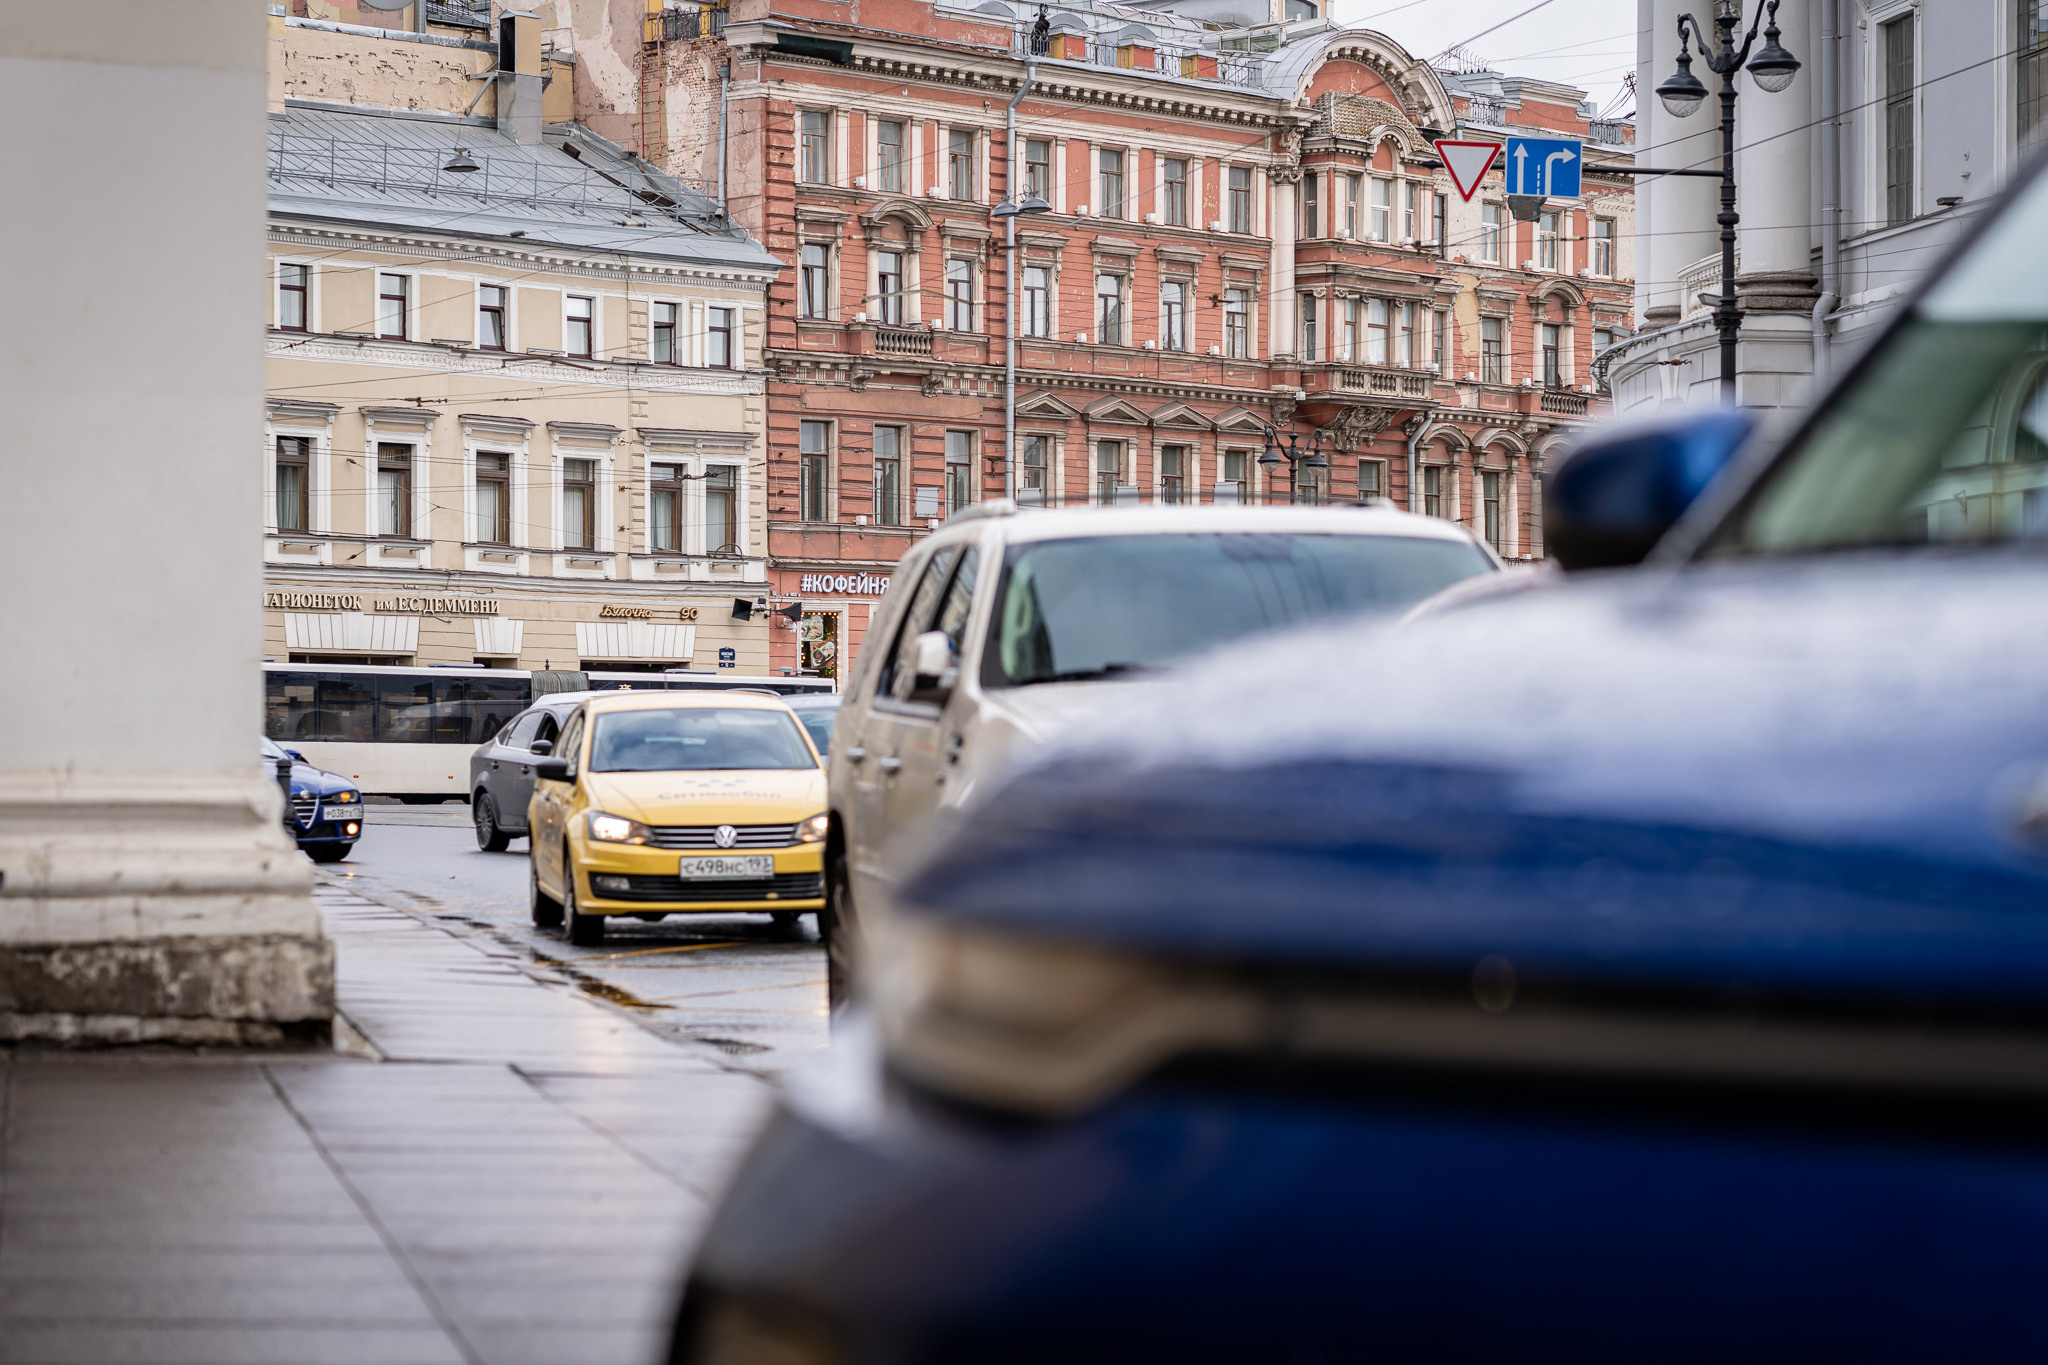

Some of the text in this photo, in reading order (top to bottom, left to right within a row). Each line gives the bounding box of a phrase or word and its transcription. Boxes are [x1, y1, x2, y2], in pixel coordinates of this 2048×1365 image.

[801, 571, 890, 595] #КОФЕЙНЯ
[680, 607, 699, 620] 90
[684, 860, 744, 874] С498НС
